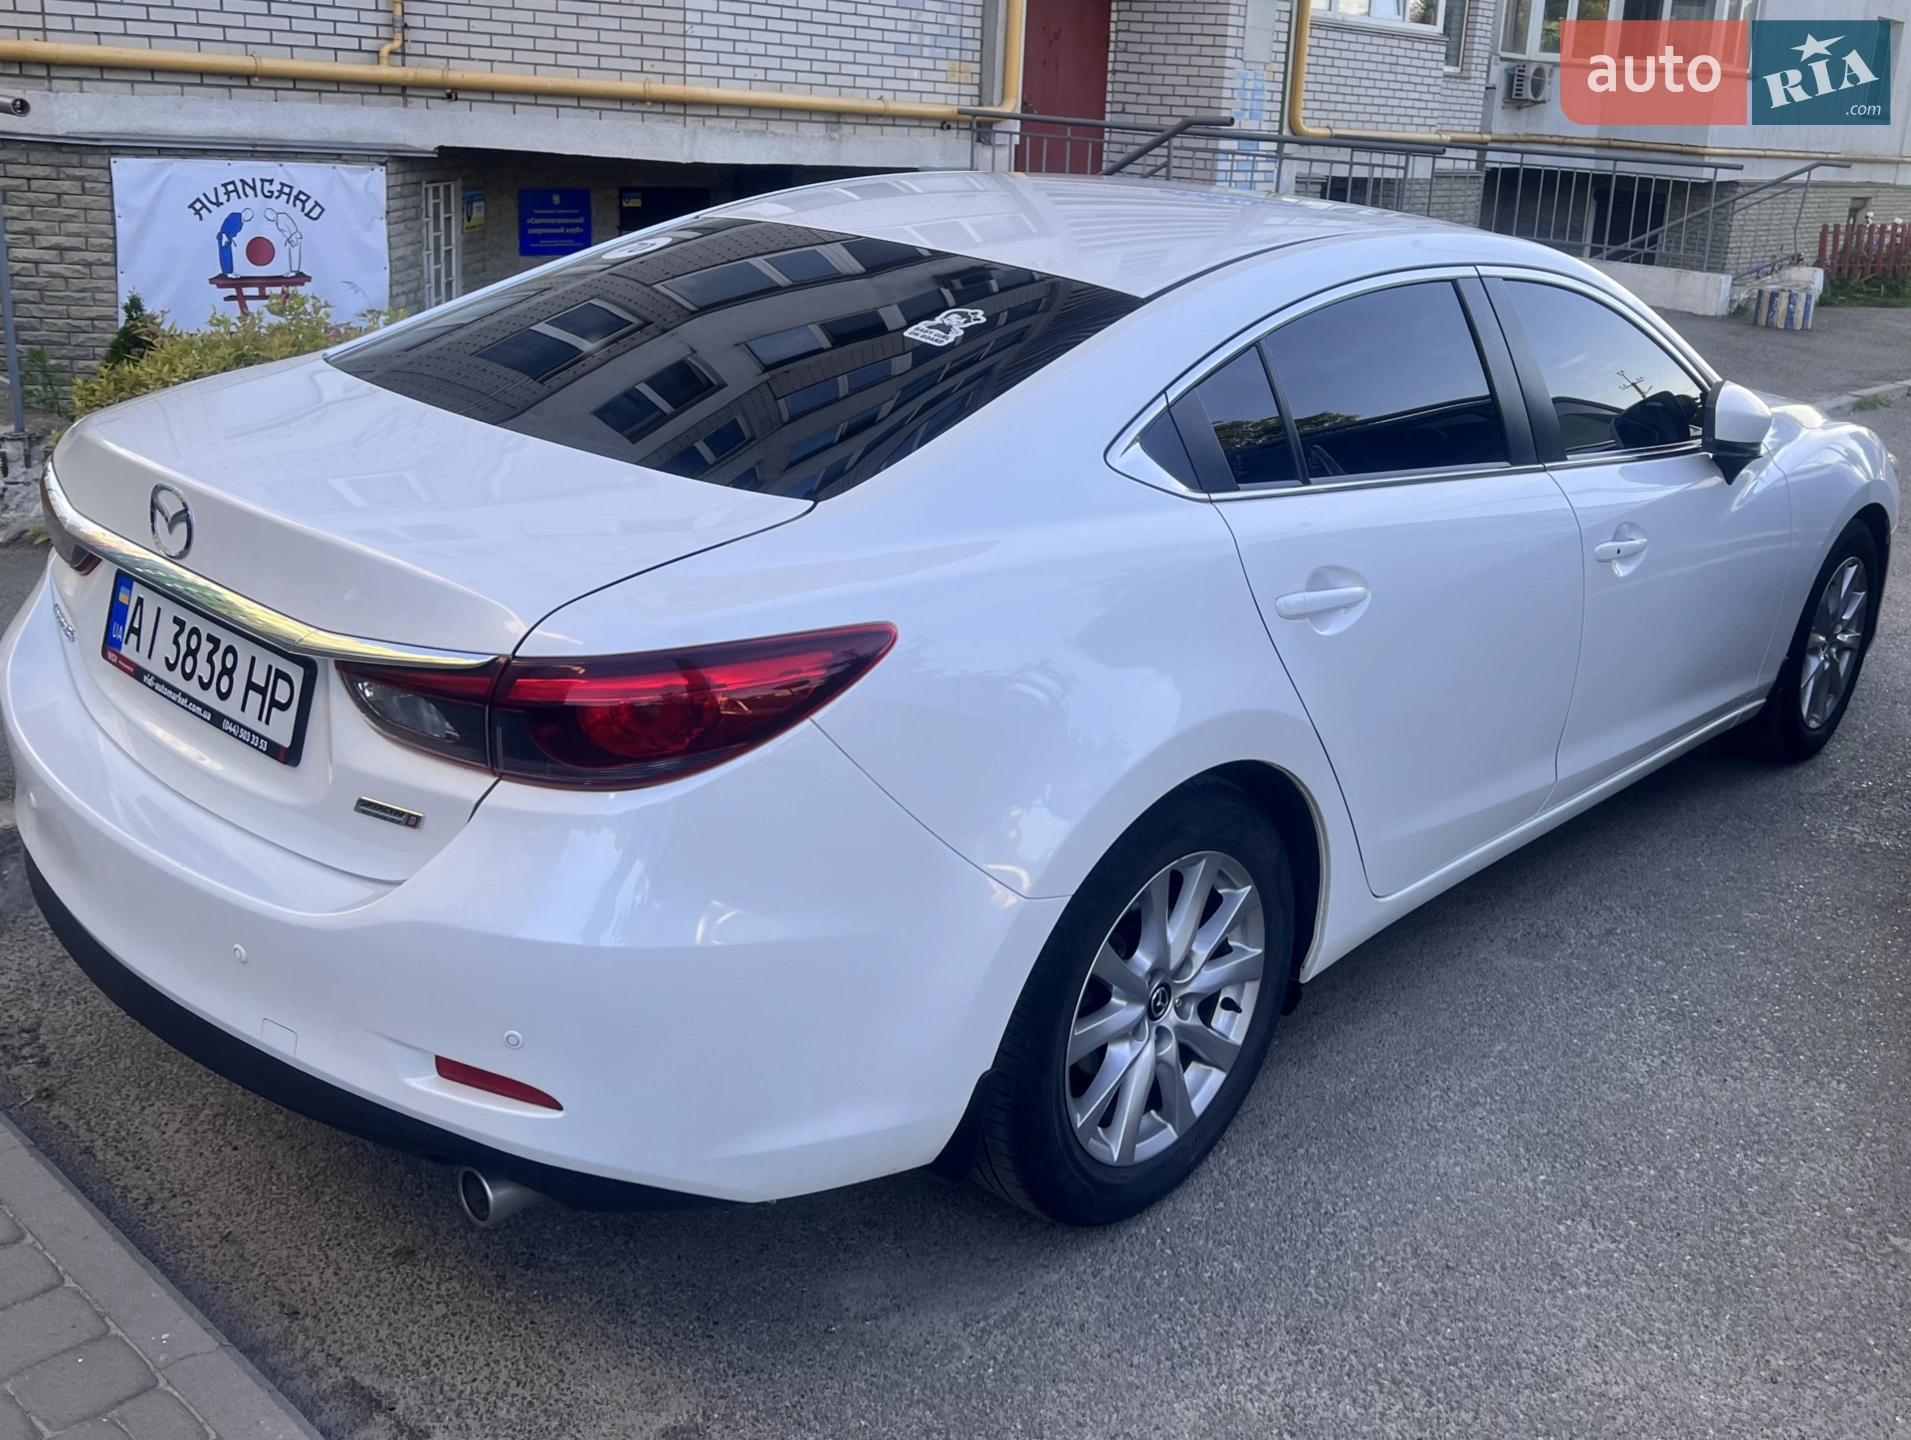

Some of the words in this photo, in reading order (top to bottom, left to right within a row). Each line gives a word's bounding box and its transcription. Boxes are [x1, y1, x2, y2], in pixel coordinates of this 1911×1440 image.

[187, 177, 326, 222] AVANGARD
[913, 326, 935, 336] BABY
[920, 334, 945, 344] BOARD
[112, 622, 123, 643] UA
[164, 615, 239, 702] 3838
[240, 655, 295, 726] HP
[143, 673, 212, 721] vidi-automarket.com.ua
[222, 718, 240, 737] (044)
[239, 727, 251, 742] 503
[250, 734, 259, 747] 33
